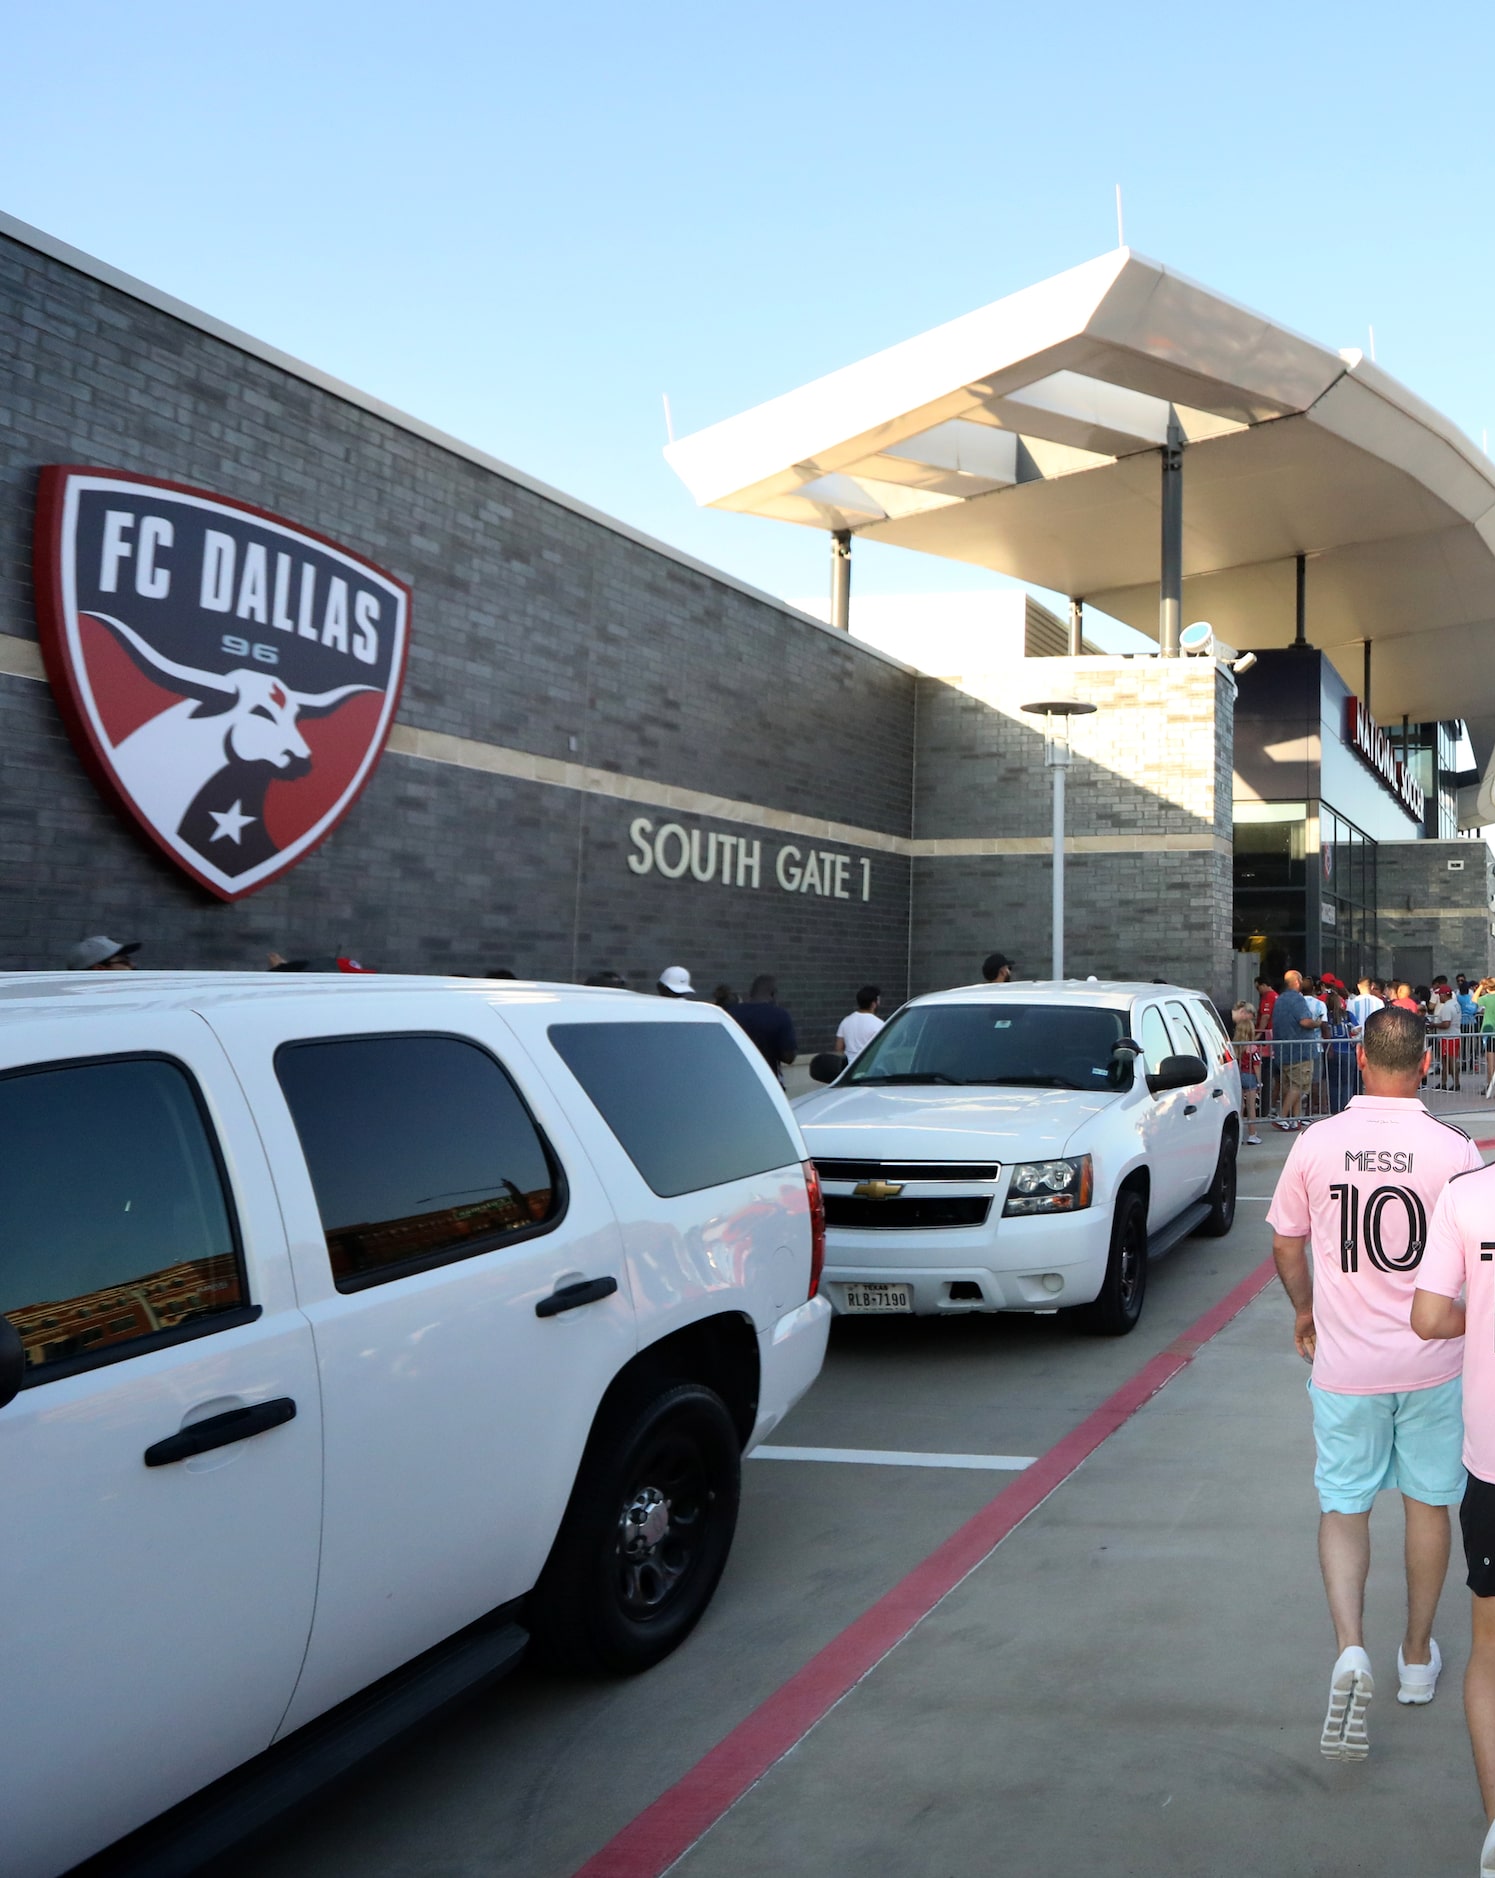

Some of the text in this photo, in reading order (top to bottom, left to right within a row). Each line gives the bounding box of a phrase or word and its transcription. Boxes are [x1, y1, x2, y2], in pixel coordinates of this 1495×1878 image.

[100, 510, 381, 666] FC DALLAS
[220, 634, 281, 666] 96
[1353, 698, 1425, 823] NATIONAL SOCCER
[627, 817, 871, 902] SOUTH GATE 1
[1345, 1150, 1414, 1174] MESSI
[1329, 1183, 1428, 1273] 10
